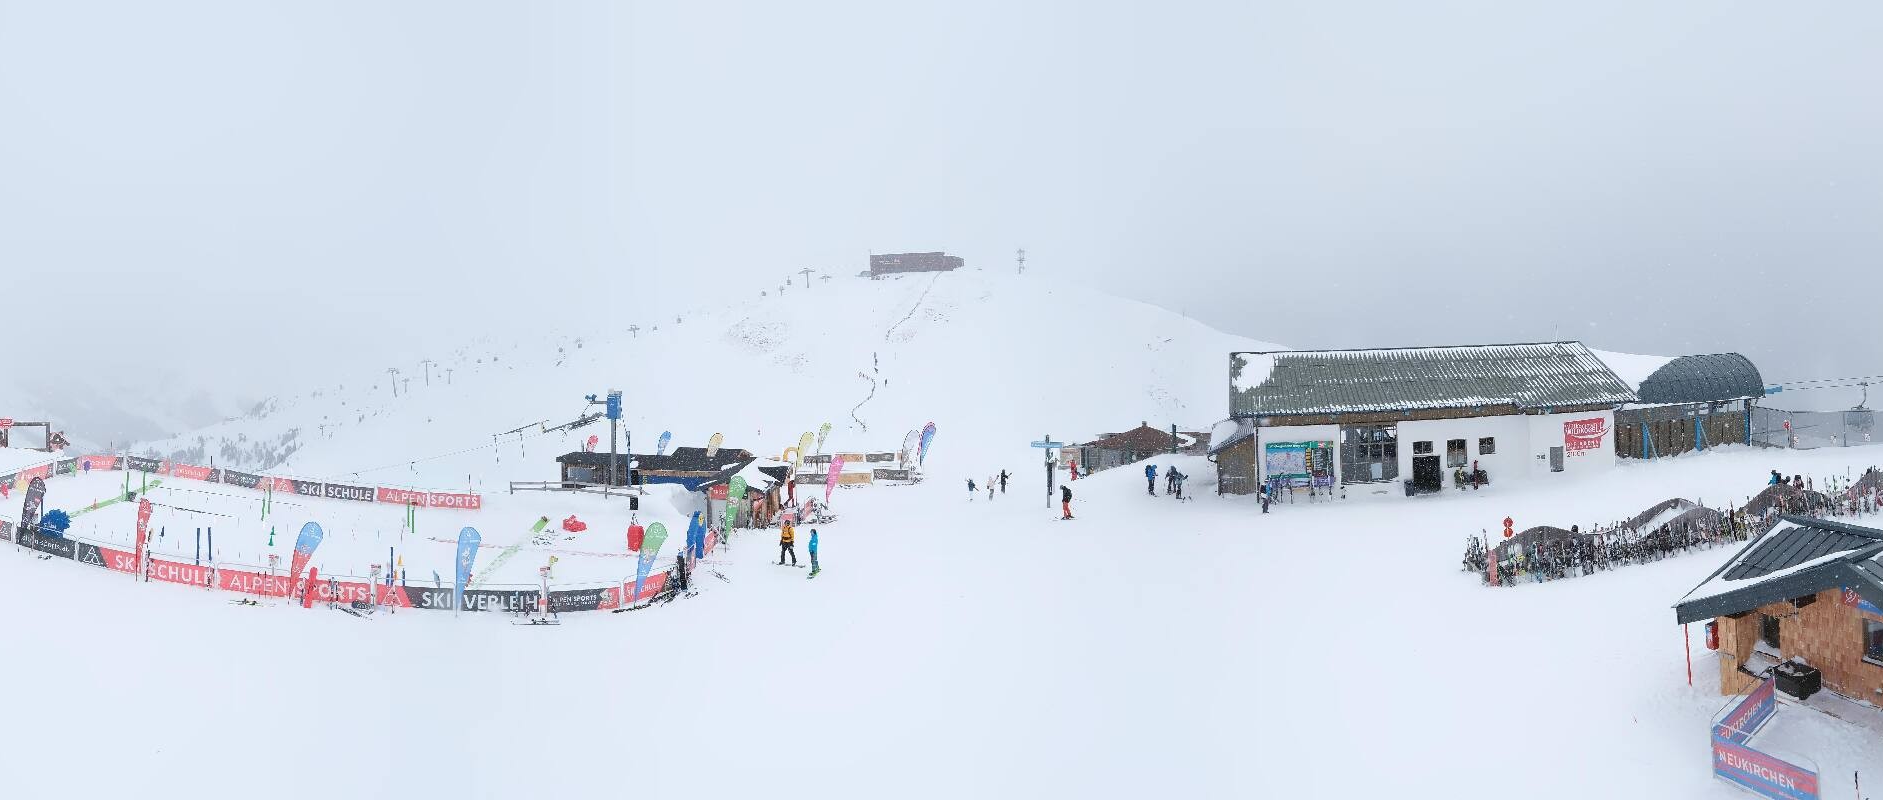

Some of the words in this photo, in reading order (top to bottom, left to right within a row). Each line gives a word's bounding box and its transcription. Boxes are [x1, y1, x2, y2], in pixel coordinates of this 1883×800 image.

[301, 483, 321, 496] SKI
[327, 486, 372, 501] SCHULE
[385, 491, 425, 505] ALPEN
[430, 494, 478, 507] SPORTS
[229, 574, 287, 594] ALPEN
[421, 590, 452, 609] SKI
[463, 594, 538, 610] VERLEIH
[1721, 699, 1762, 739] EUKIRCHEN
[1718, 749, 1796, 791] NEUKIRCHEN
